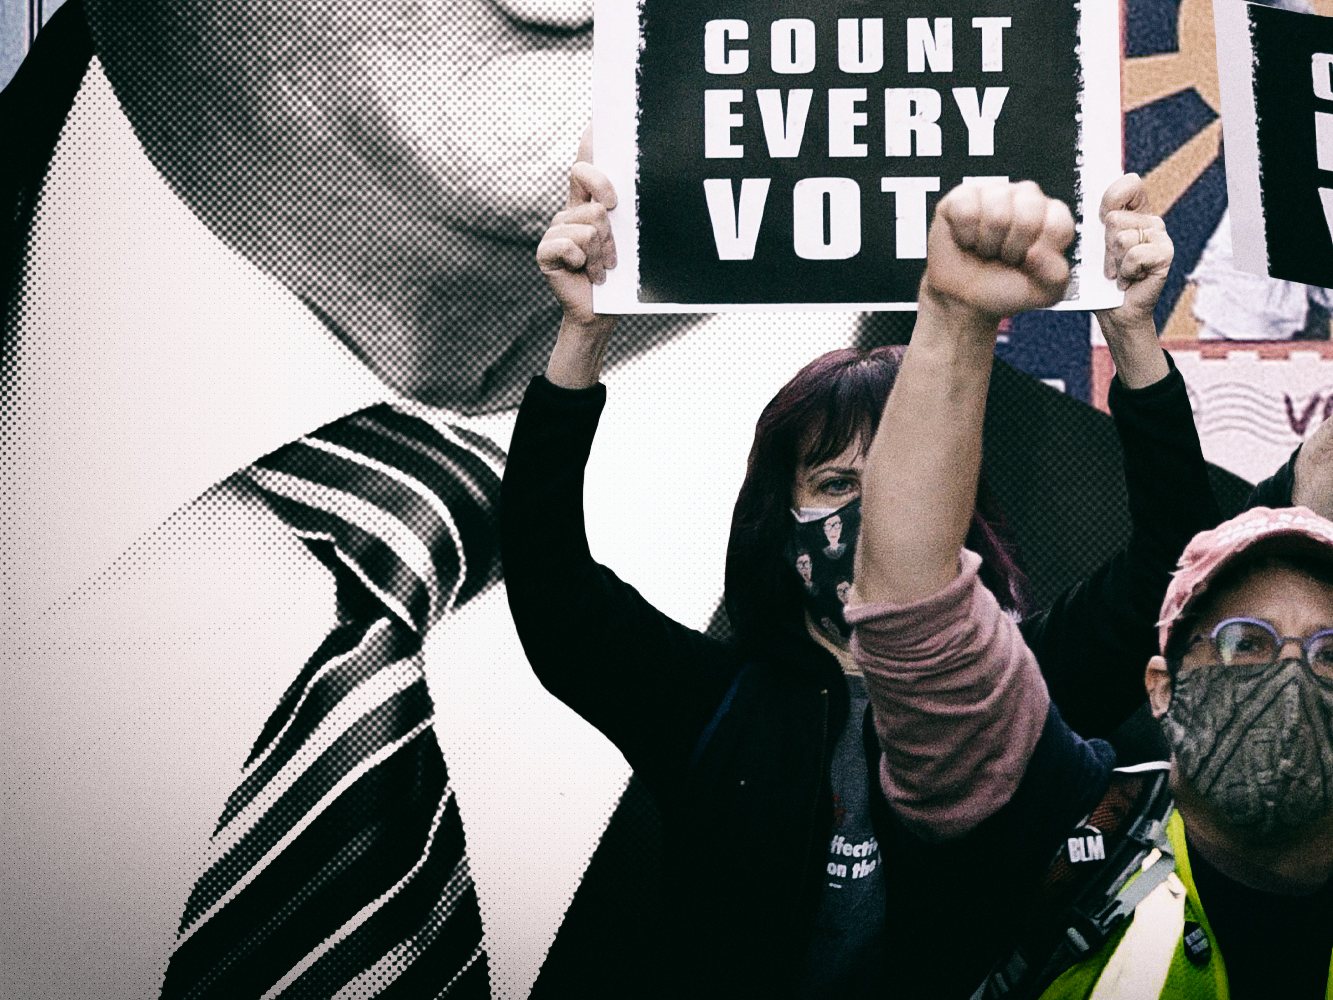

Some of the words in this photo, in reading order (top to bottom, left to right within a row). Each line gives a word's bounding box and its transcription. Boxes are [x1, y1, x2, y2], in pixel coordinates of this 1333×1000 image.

[703, 16, 1013, 76] COUNT
[703, 86, 1011, 160] EVERY
[702, 174, 1011, 262] VOT
[826, 861, 848, 879] on
[1067, 835, 1106, 864] BLM
